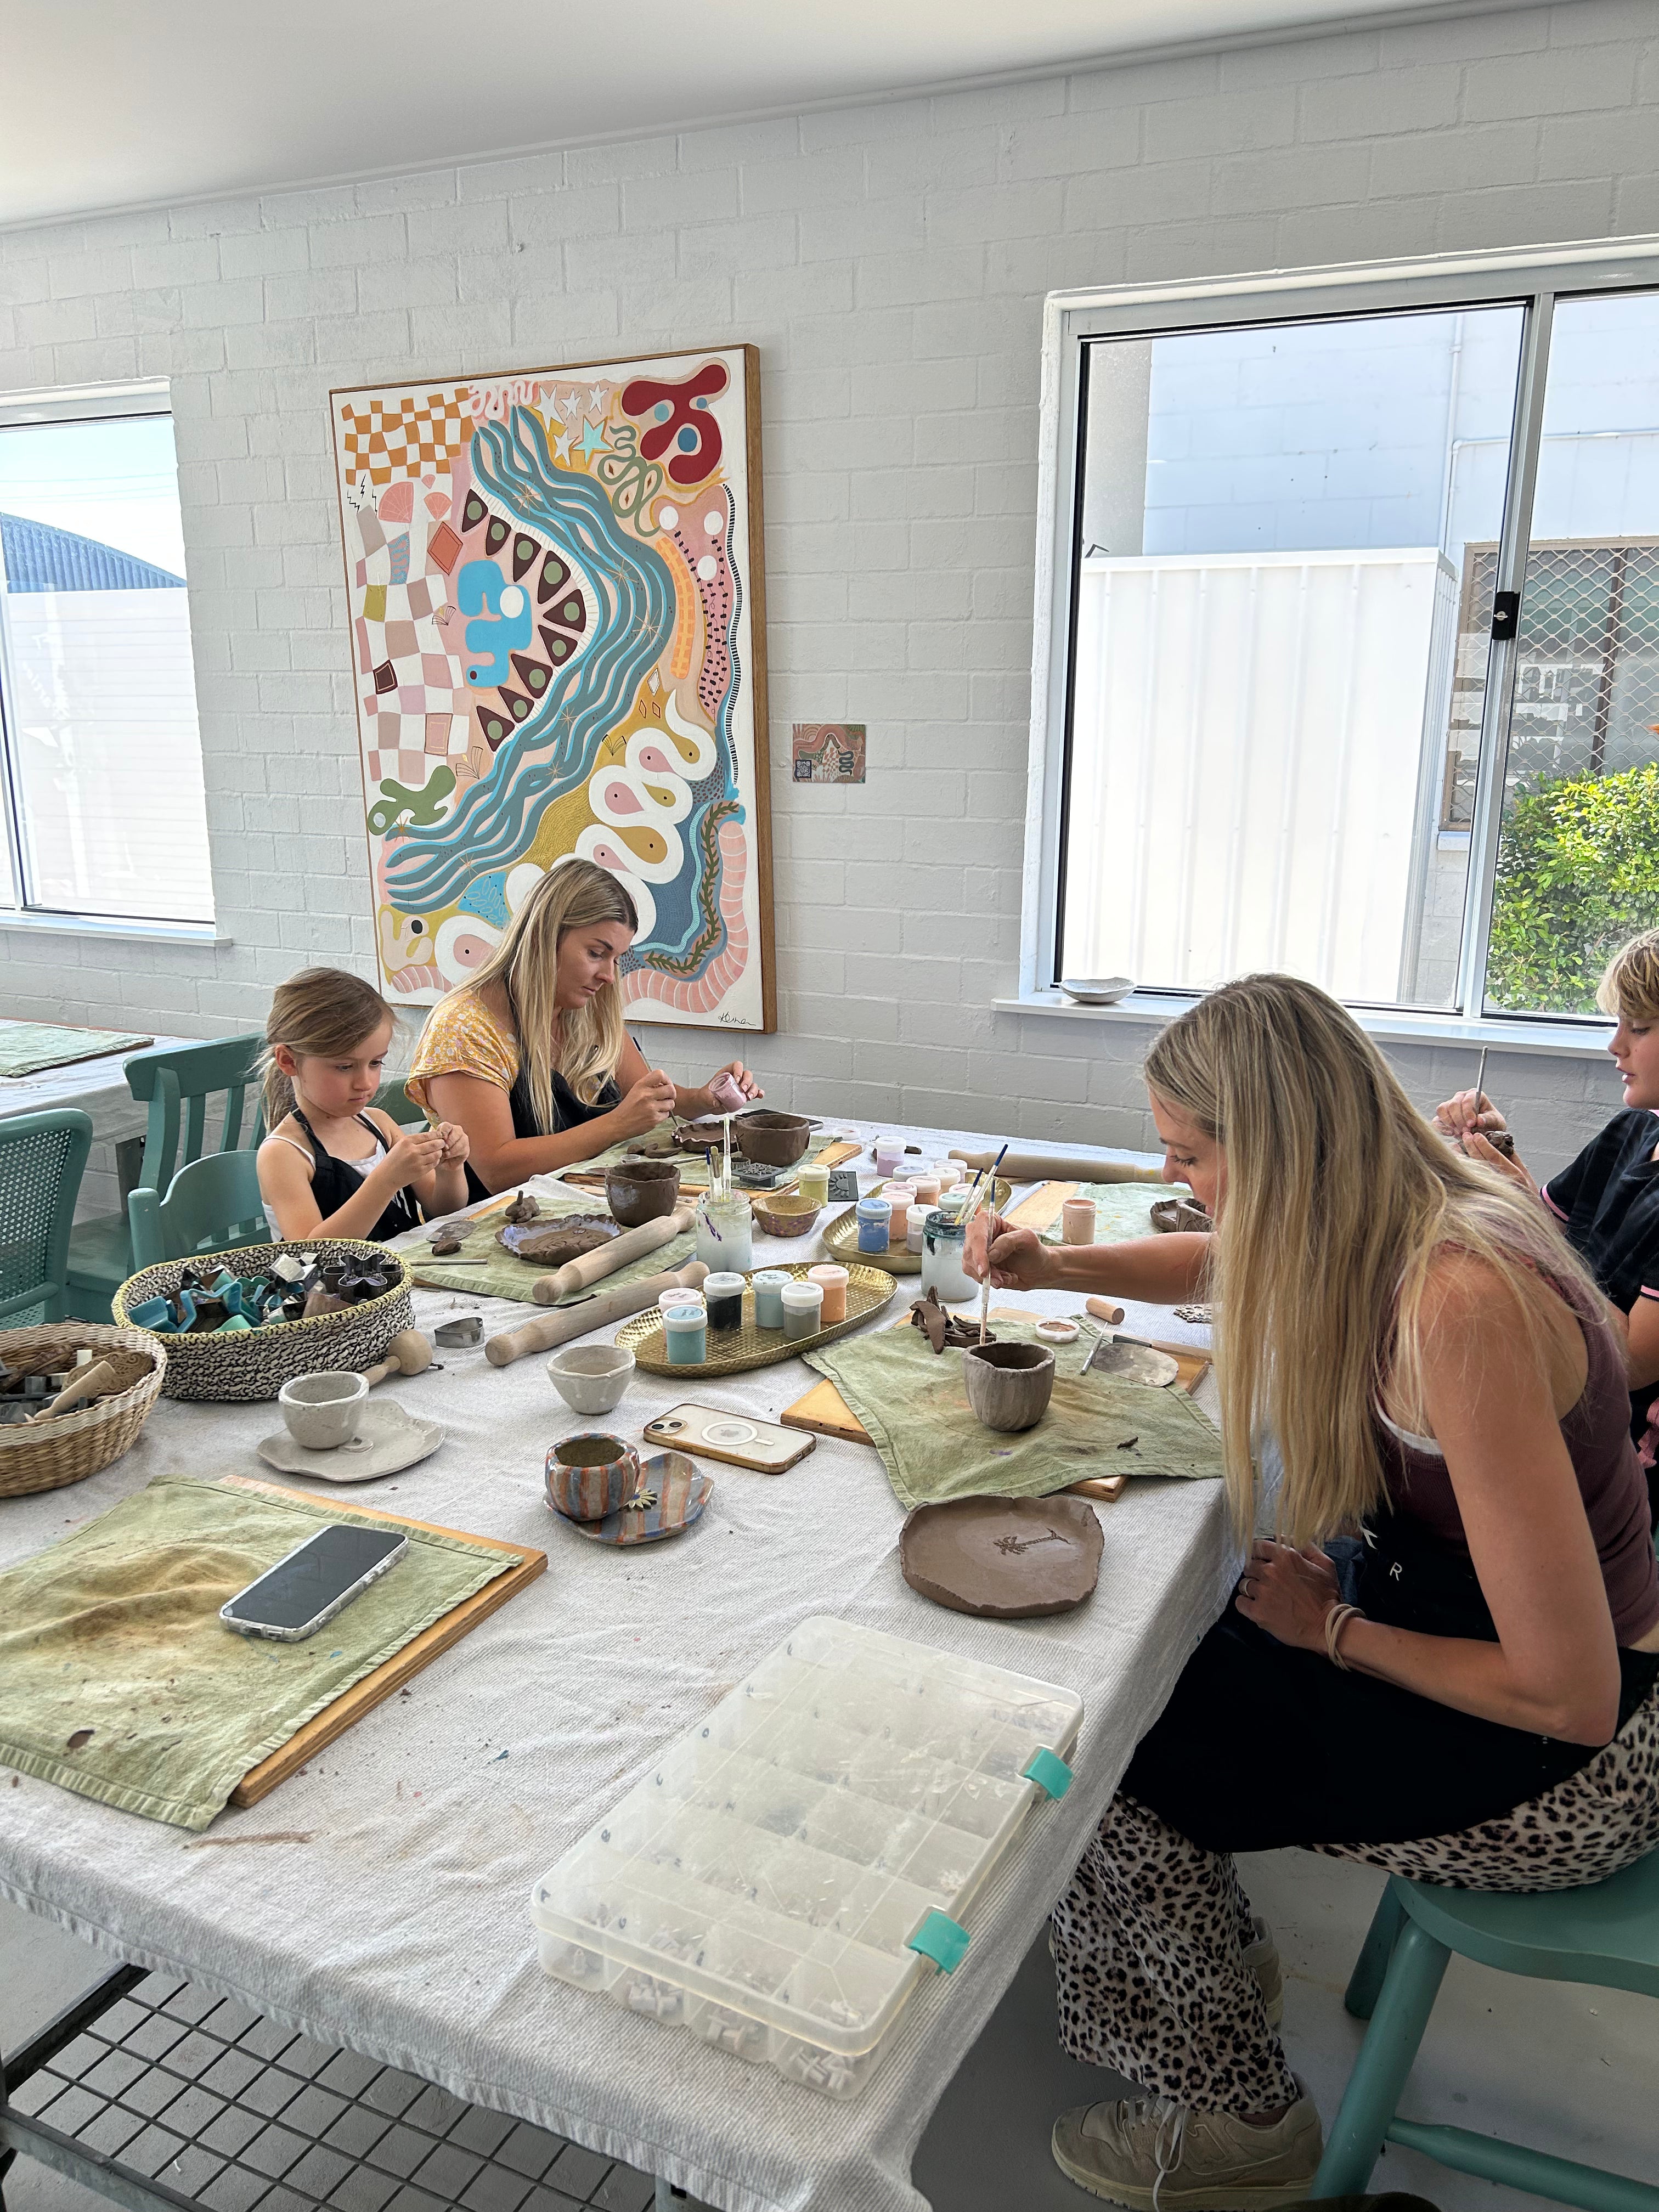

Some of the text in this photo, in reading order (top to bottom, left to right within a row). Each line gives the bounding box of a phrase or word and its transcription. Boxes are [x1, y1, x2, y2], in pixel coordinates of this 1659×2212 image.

[1389, 1562, 1403, 1581] R
[600, 1829, 611, 1843] B
[540, 1887, 551, 1903] A
